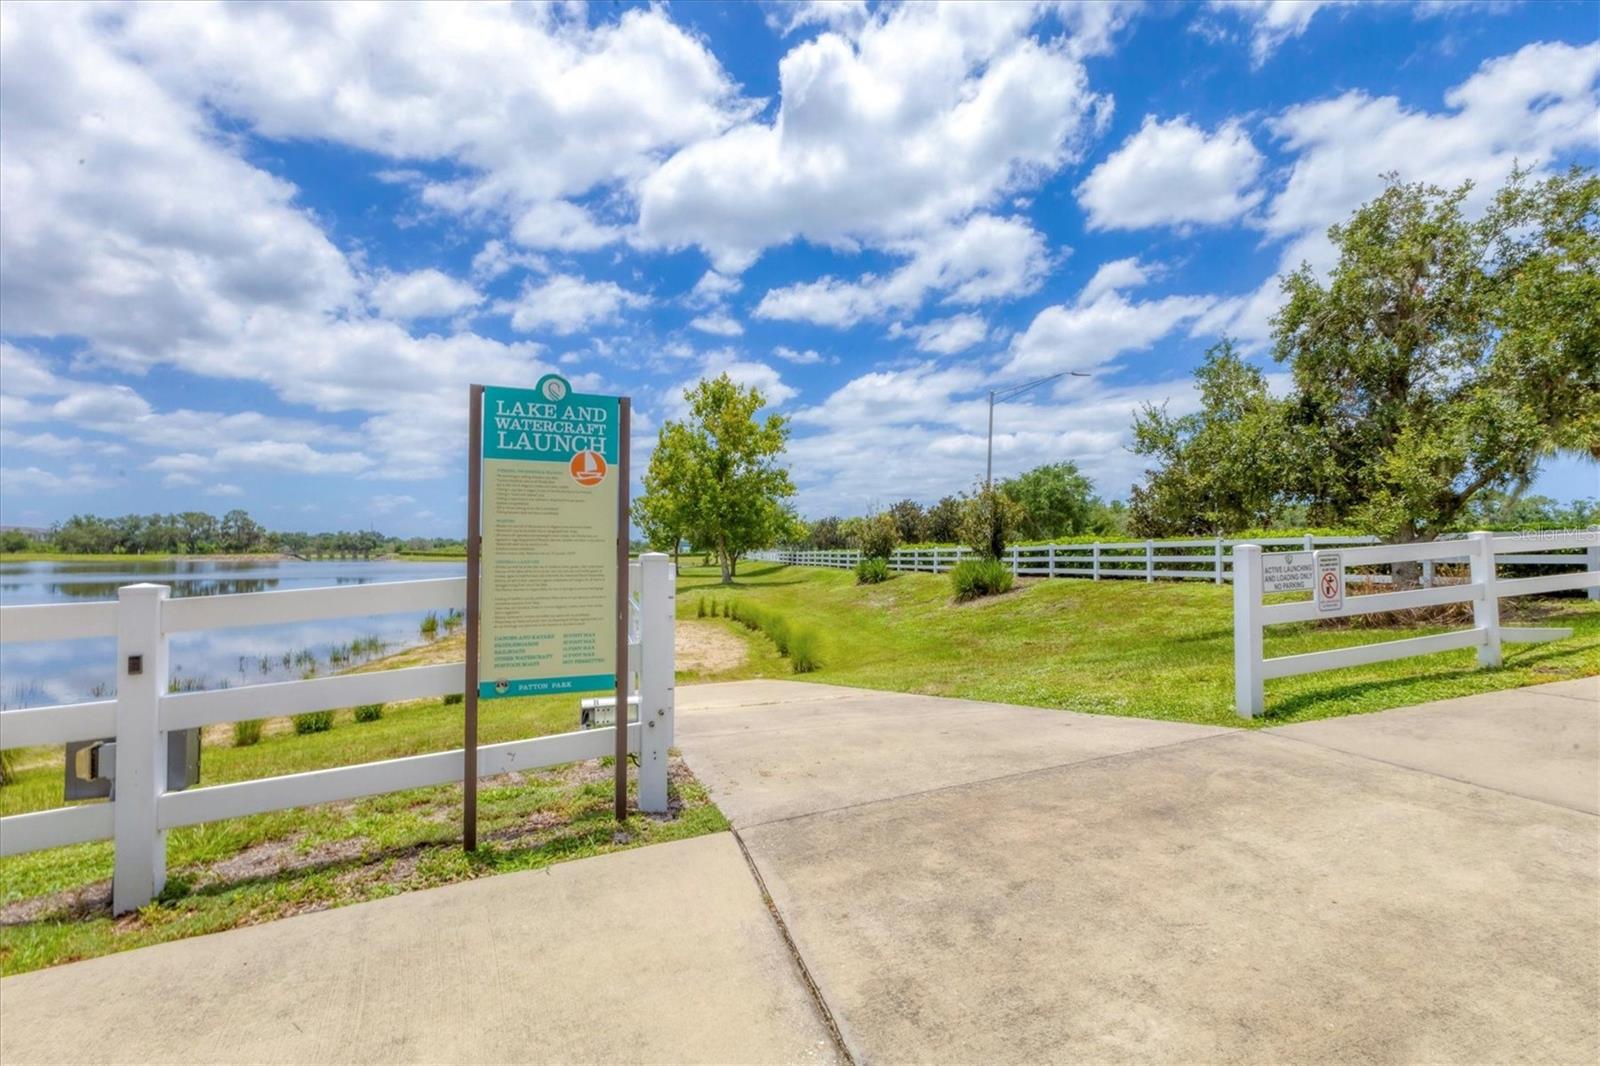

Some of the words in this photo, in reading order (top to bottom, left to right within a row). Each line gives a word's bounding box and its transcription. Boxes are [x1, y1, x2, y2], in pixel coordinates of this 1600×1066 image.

[496, 400, 557, 419] LAKE
[561, 405, 607, 422] AND
[495, 417, 606, 436] WATERCRAFT
[497, 431, 607, 455] LAUNCH
[1265, 566, 1282, 574] ACTIVE
[1283, 564, 1312, 573] LAUNCHING
[1276, 574, 1299, 582] LOADING
[518, 682, 549, 691] PATTON
[551, 681, 573, 689] PARK
